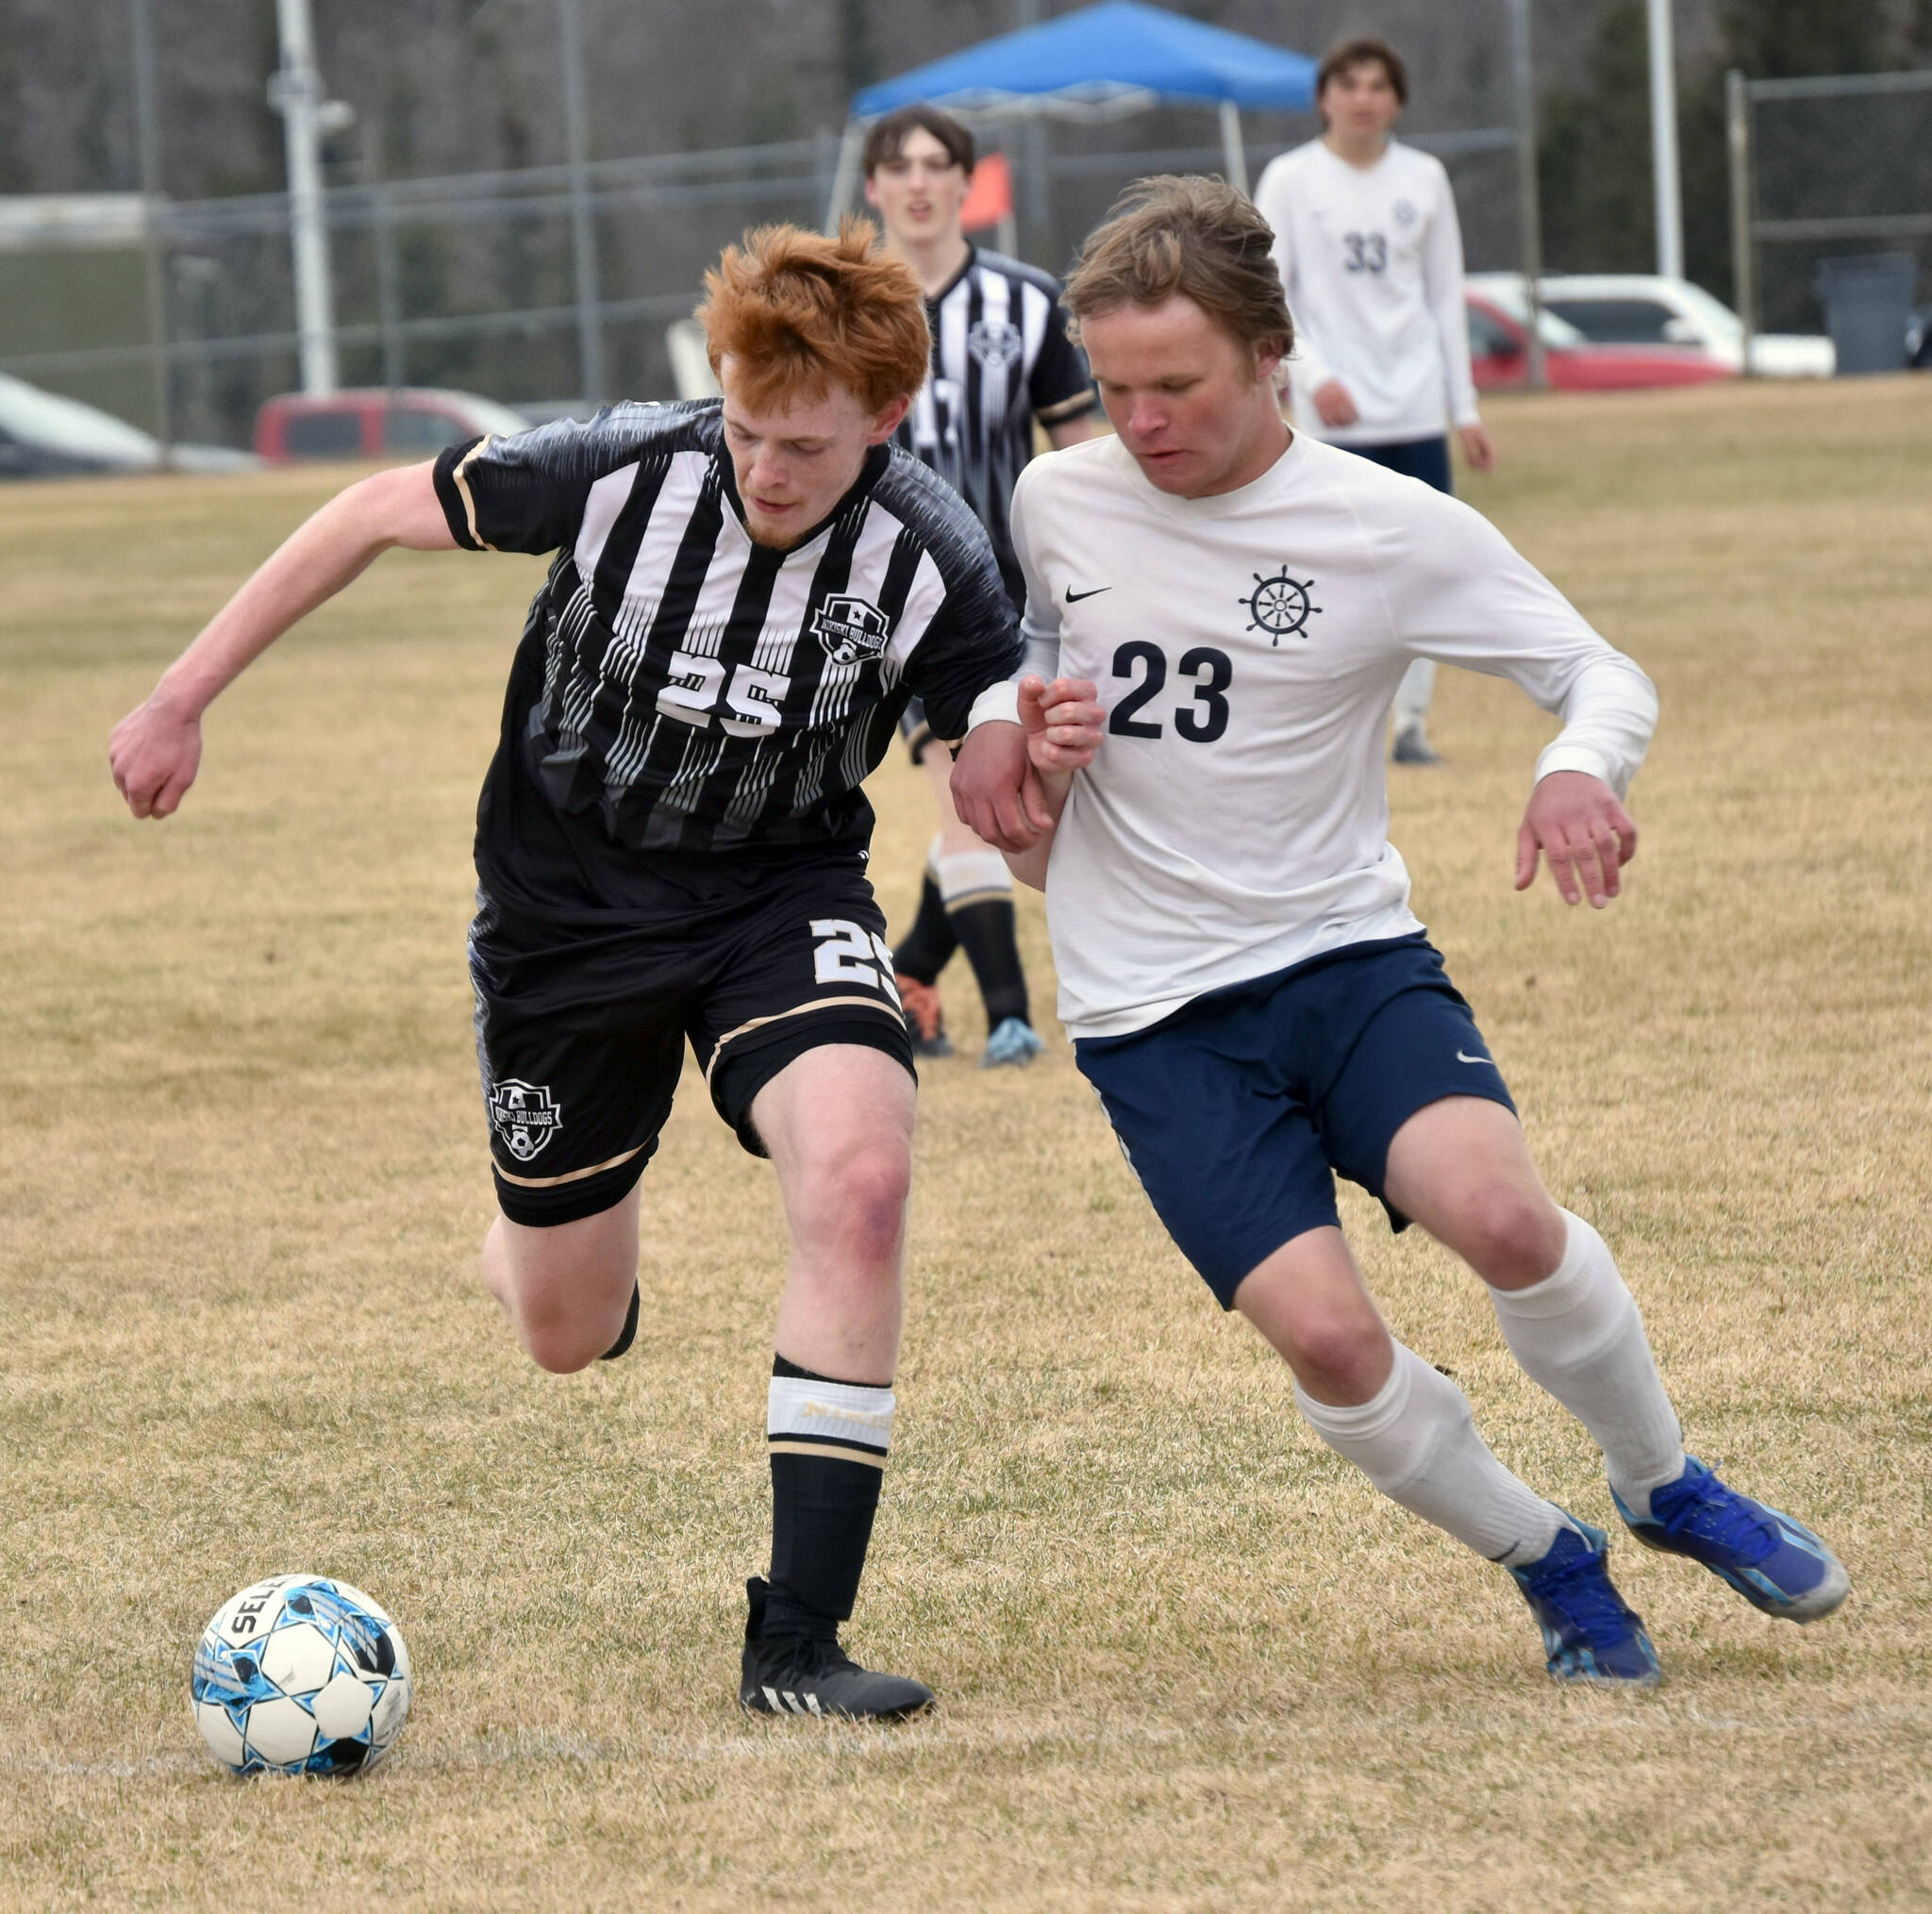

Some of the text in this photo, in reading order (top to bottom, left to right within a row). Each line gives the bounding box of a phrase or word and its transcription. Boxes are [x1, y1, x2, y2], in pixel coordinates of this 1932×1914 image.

[1343, 231, 1387, 273] 33
[655, 650, 791, 738] 25
[1108, 640, 1233, 743] 23
[516, 1109, 553, 1125] BULLDOGS
